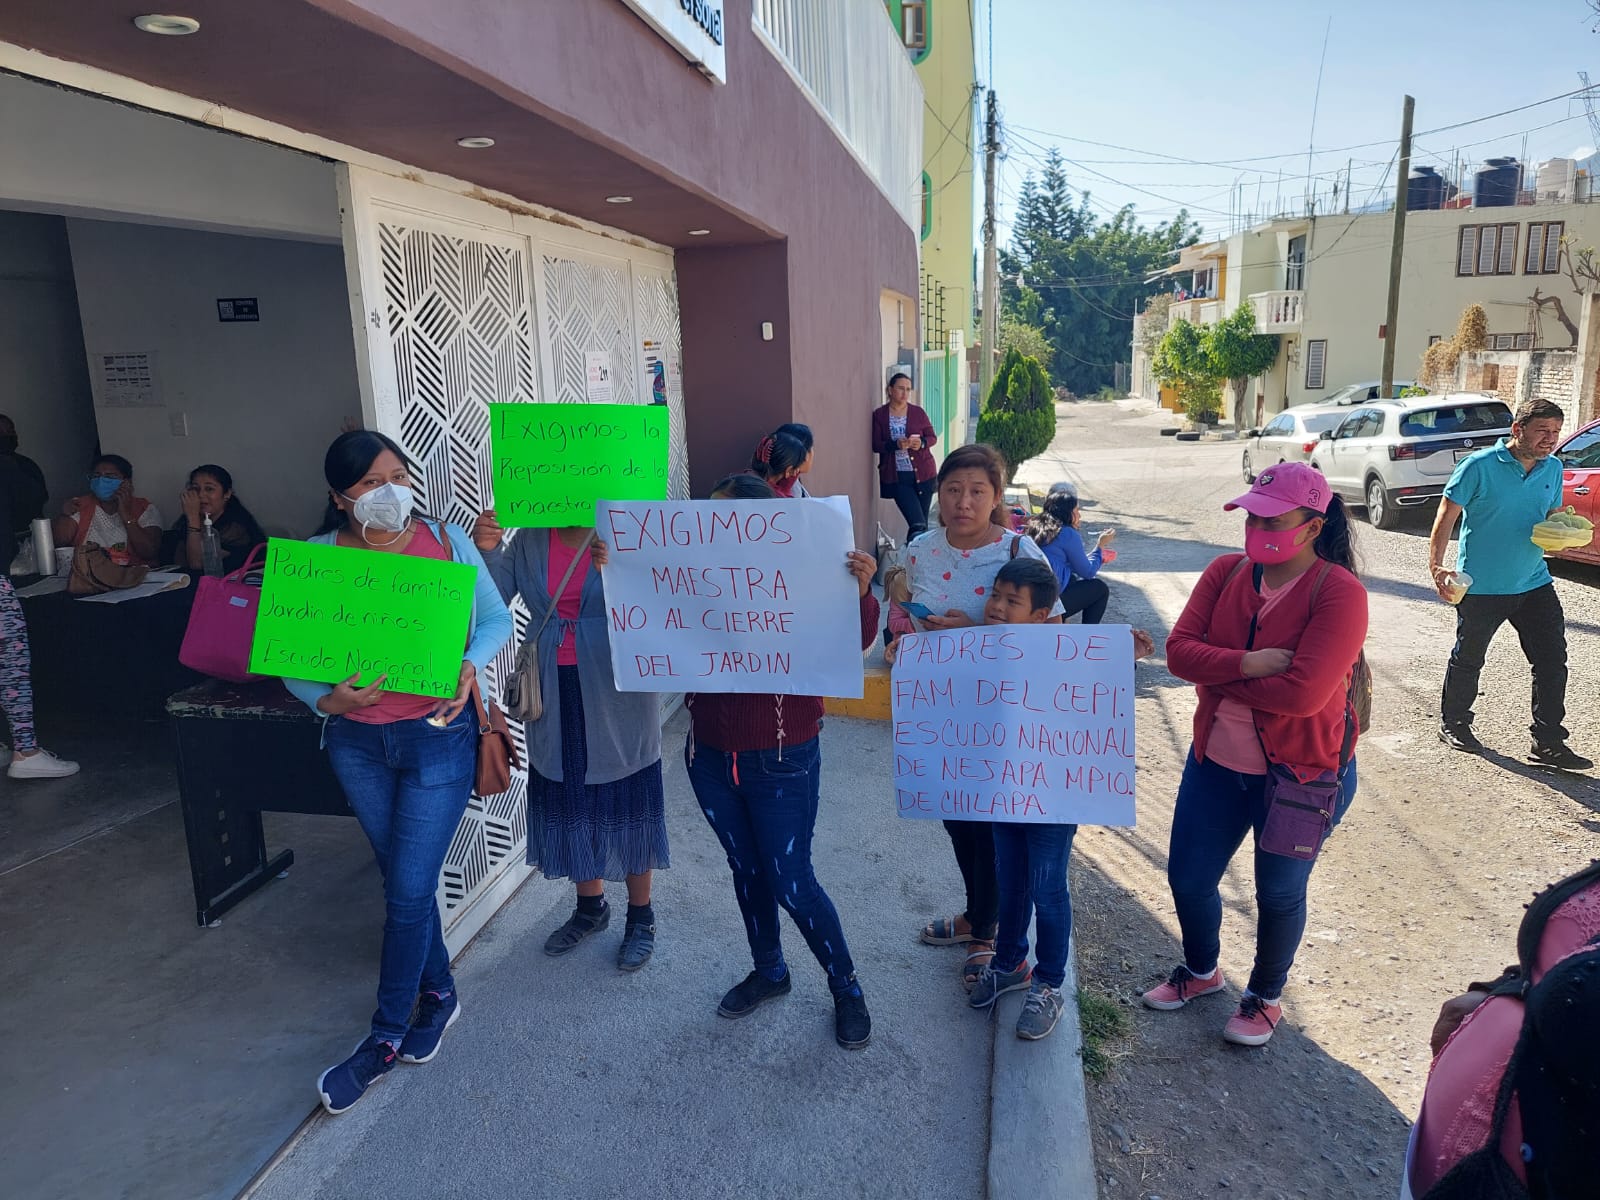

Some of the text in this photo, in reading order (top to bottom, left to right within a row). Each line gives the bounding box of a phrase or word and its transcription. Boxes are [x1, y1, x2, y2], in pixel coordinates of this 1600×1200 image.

[500, 410, 660, 453] Exigimos la
[622, 459, 646, 479] de
[653, 457, 666, 478] la
[1308, 489, 1320, 507] 3
[608, 508, 792, 551] EXIGIMOS
[272, 547, 461, 601] Padres de familia
[652, 566, 788, 600] MAESTRA
[332, 604, 356, 627] de
[362, 610, 426, 632] niños
[611, 603, 794, 634] NO AL CIERRE
[263, 639, 433, 678] Escudo Nacional
[635, 651, 791, 678] DEL JARDIN
[899, 631, 1110, 667] PADRES DE
[896, 677, 1126, 719] FAM. DEL CEPI:
[895, 718, 1134, 757] ESCUDO NACIONAL
[895, 754, 1133, 796] DE NEJAPA MPIO.
[898, 789, 1047, 816] DE CHILAPA.
